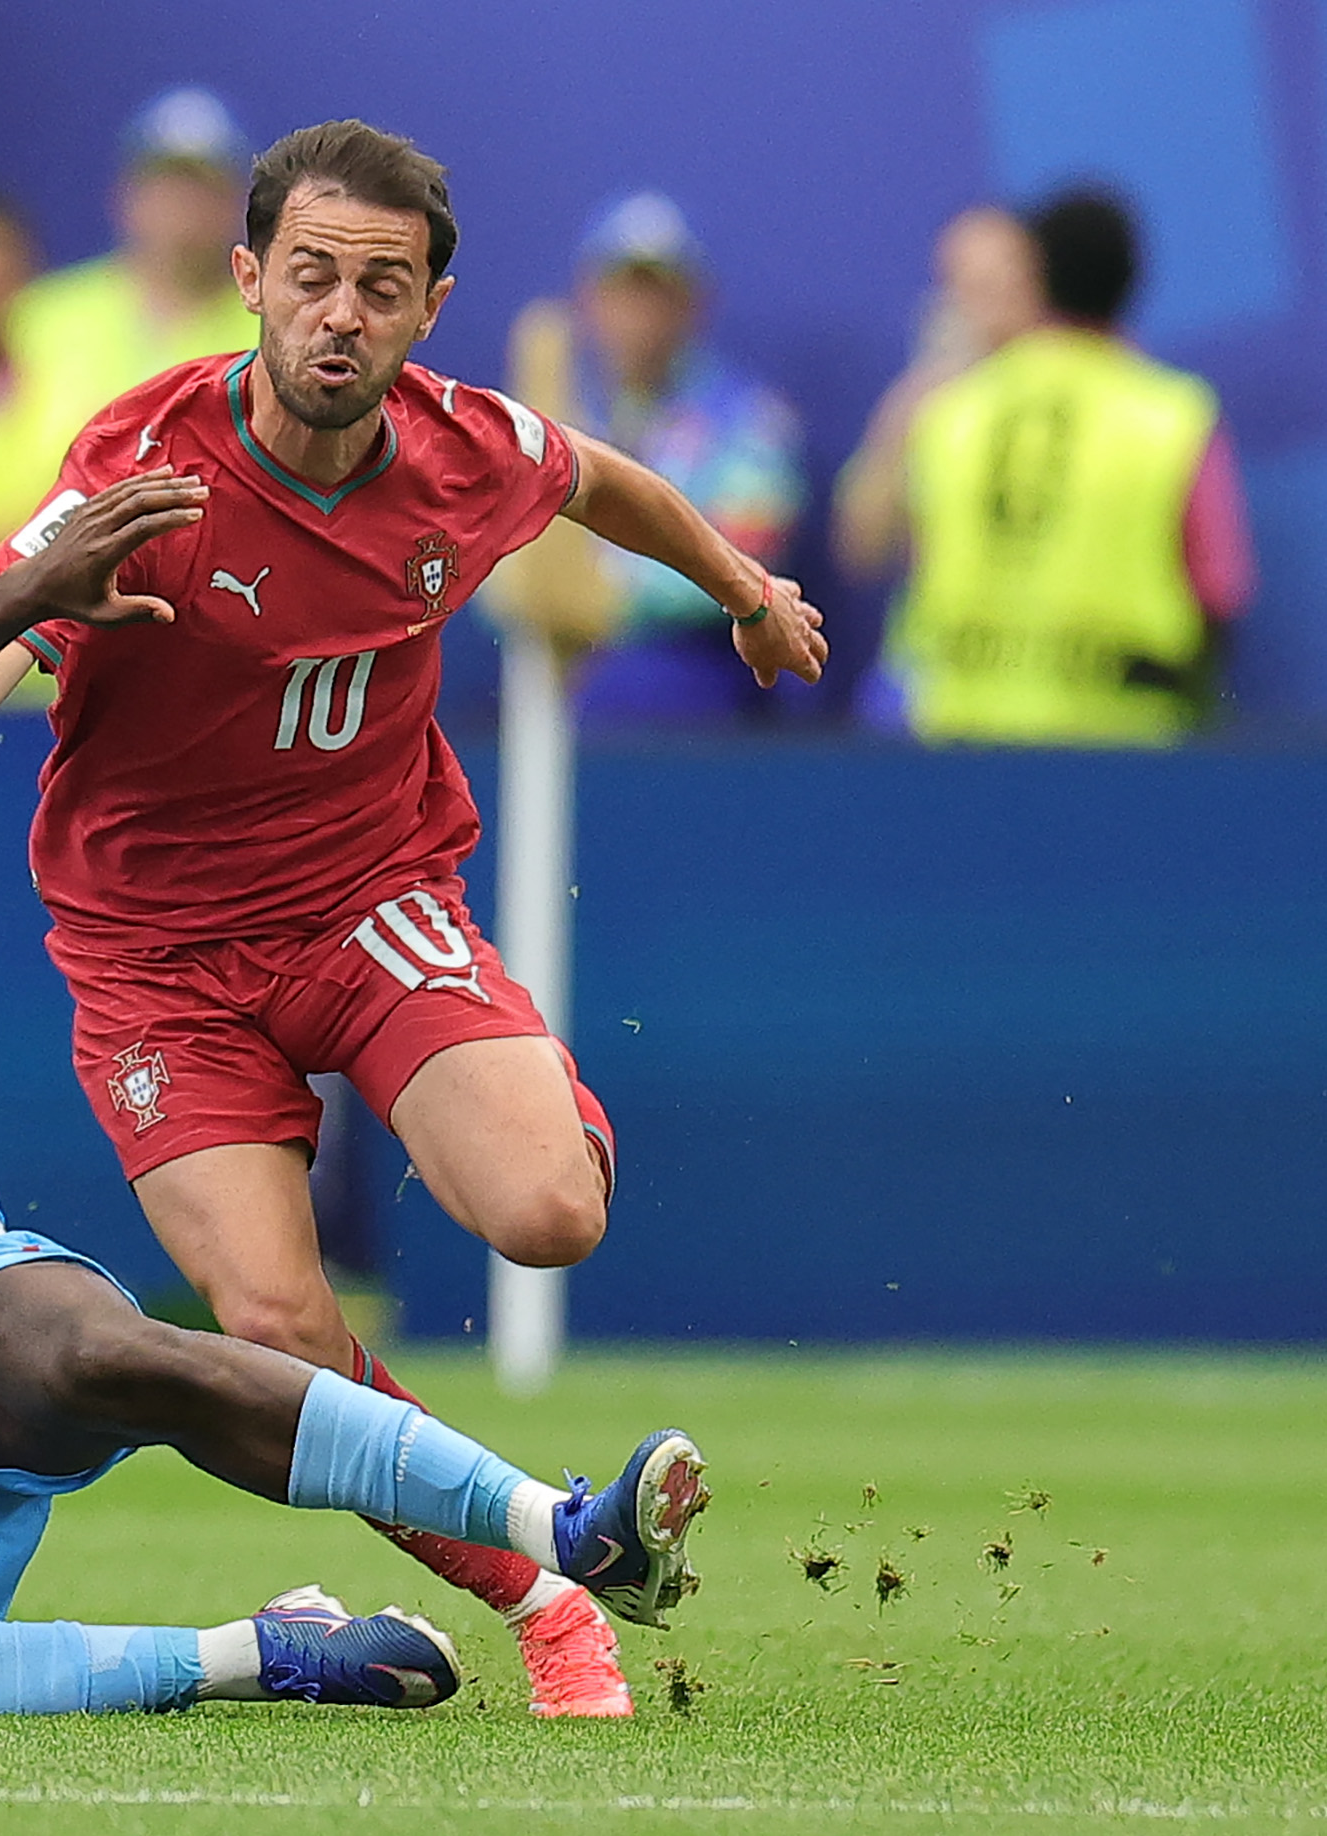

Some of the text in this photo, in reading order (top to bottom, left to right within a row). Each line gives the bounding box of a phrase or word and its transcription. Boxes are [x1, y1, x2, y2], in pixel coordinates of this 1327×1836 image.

[273, 650, 377, 751] 10
[341, 889, 473, 991] 10
[395, 1415, 425, 1482] umbro
